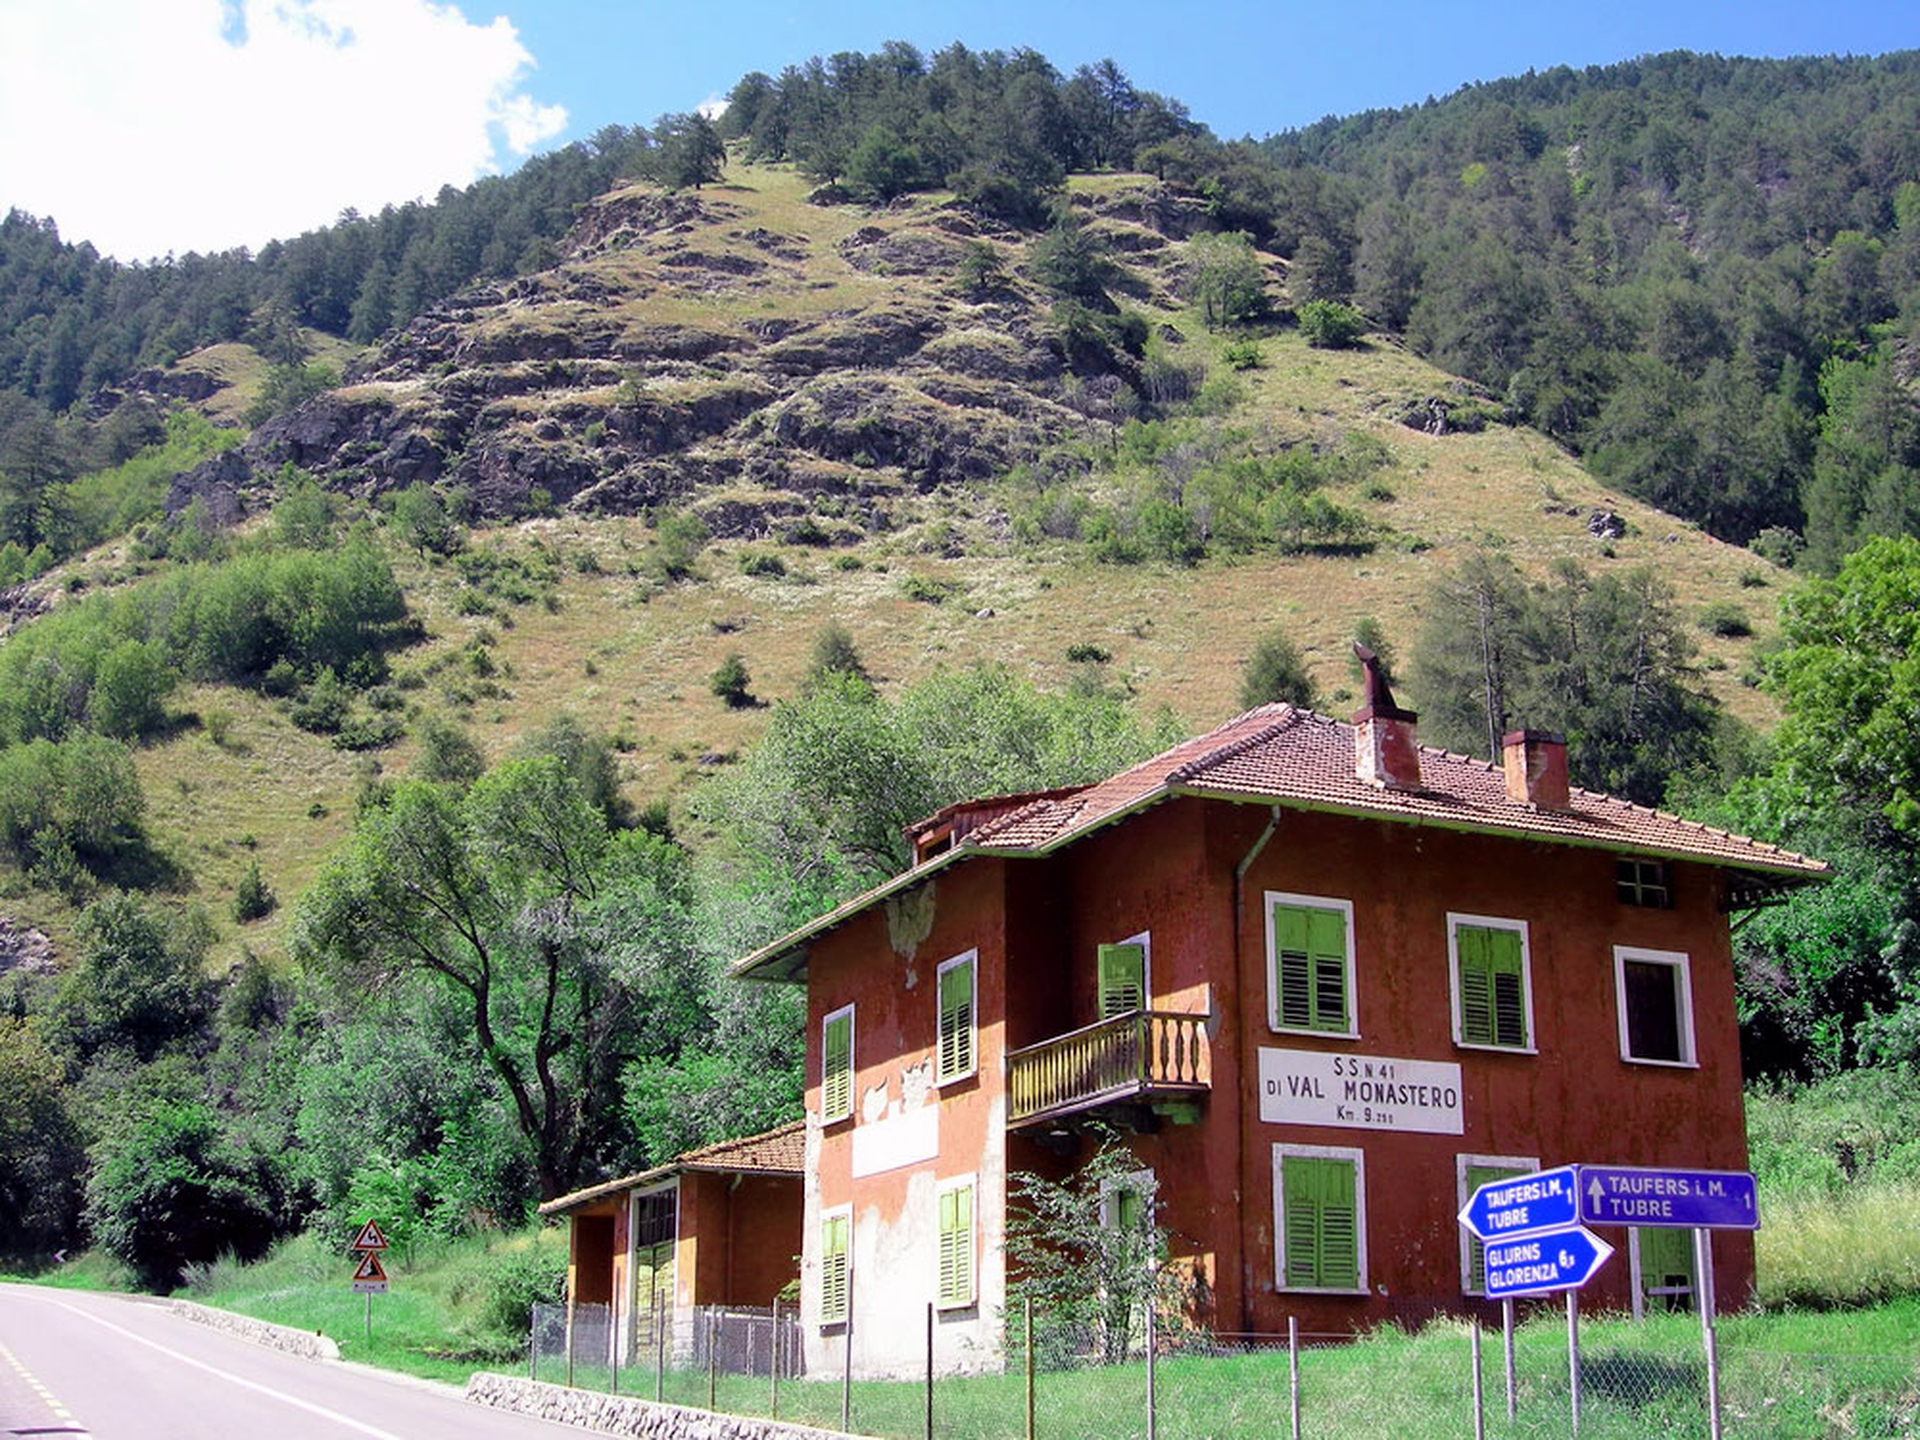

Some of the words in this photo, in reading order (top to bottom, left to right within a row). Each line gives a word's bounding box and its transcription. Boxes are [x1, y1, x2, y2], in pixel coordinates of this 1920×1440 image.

[1267, 1080, 1281, 1096] DI
[1287, 1075, 1325, 1098] VAL
[1345, 1080, 1457, 1109] MONASTERO
[1486, 1182, 1540, 1208] TAUFERS
[1566, 1187, 1573, 1205] 1
[1609, 1176, 1690, 1196] TAUFERS
[1610, 1199, 1673, 1217] TUBRE
[1744, 1193, 1751, 1210] 1
[1487, 1206, 1529, 1230] TUBRE
[1489, 1243, 1541, 1267] GLURNS
[1490, 1262, 1559, 1289] GLORENZA
